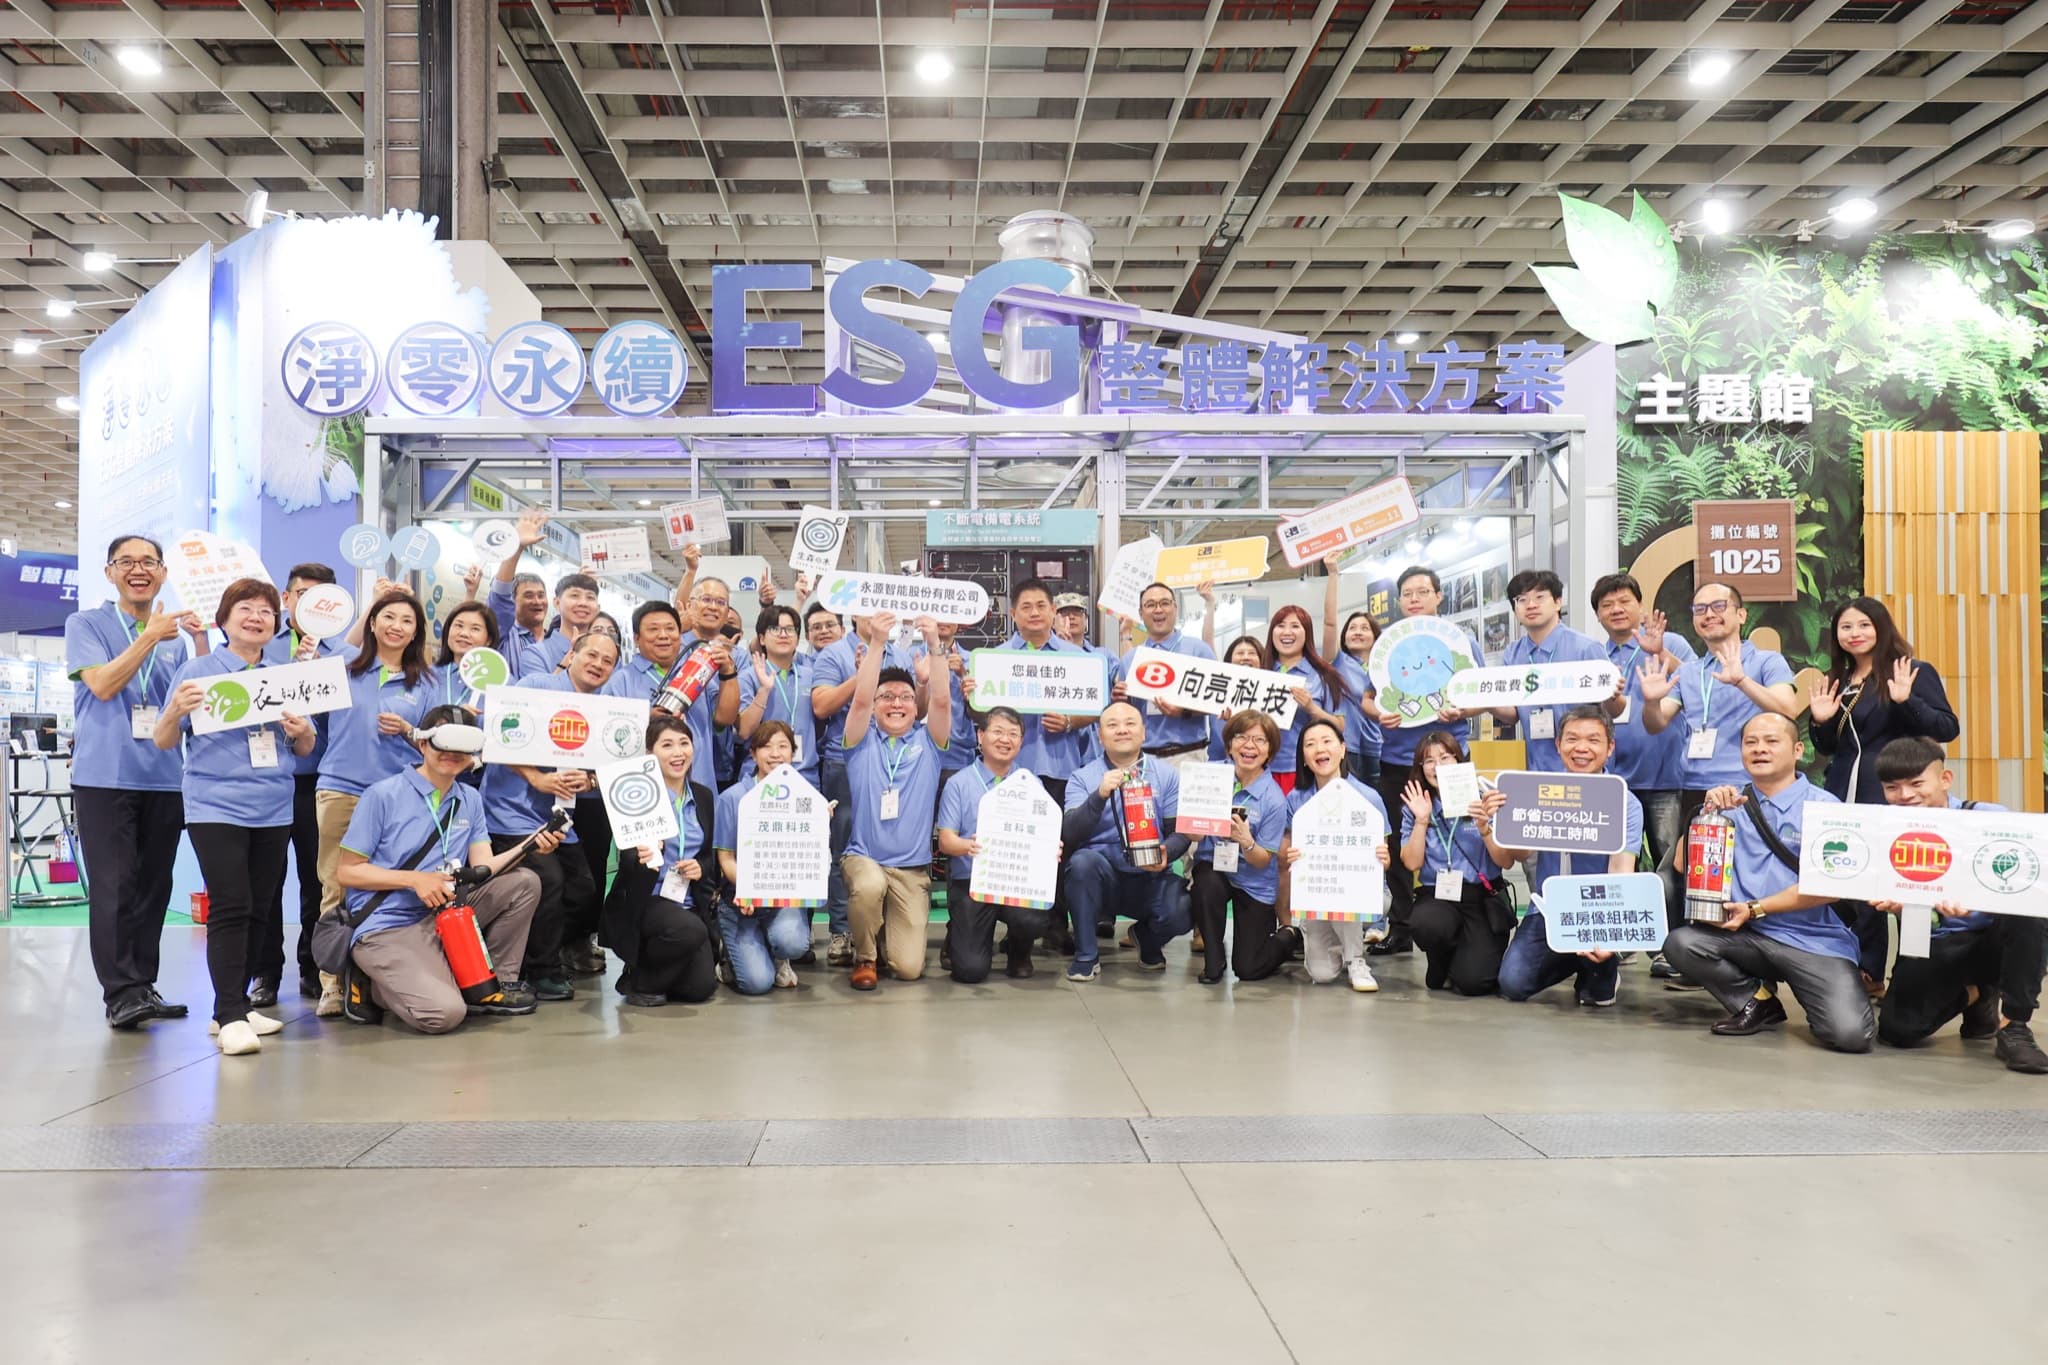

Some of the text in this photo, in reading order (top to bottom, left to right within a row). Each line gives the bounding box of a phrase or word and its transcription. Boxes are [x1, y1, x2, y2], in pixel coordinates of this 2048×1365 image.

[295, 258, 1567, 411] 淨零永續 ESG 整體解決方案
[1635, 372, 1814, 424] 主題館
[943, 511, 1041, 527] 不斷電備電系統
[1710, 524, 1779, 540] 攤位編號
[1710, 549, 1782, 575] 1025
[860, 581, 979, 602] 永源智能股份有限公司
[860, 600, 978, 616] EVERSOURCE-ai
[1011, 663, 1066, 680] 您最佳的
[980, 679, 1099, 701] AI節能解決方案
[1178, 667, 1292, 716] 向亮科技
[620, 815, 668, 836] 生森の木
[1512, 808, 1610, 826] 節省50%以上
[758, 821, 811, 832] 茂鼎科技
[1522, 824, 1599, 842] 的施工時間
[1560, 909, 1654, 927] 蓋房像組積木
[1561, 927, 1657, 943] 一樣簡單快速
